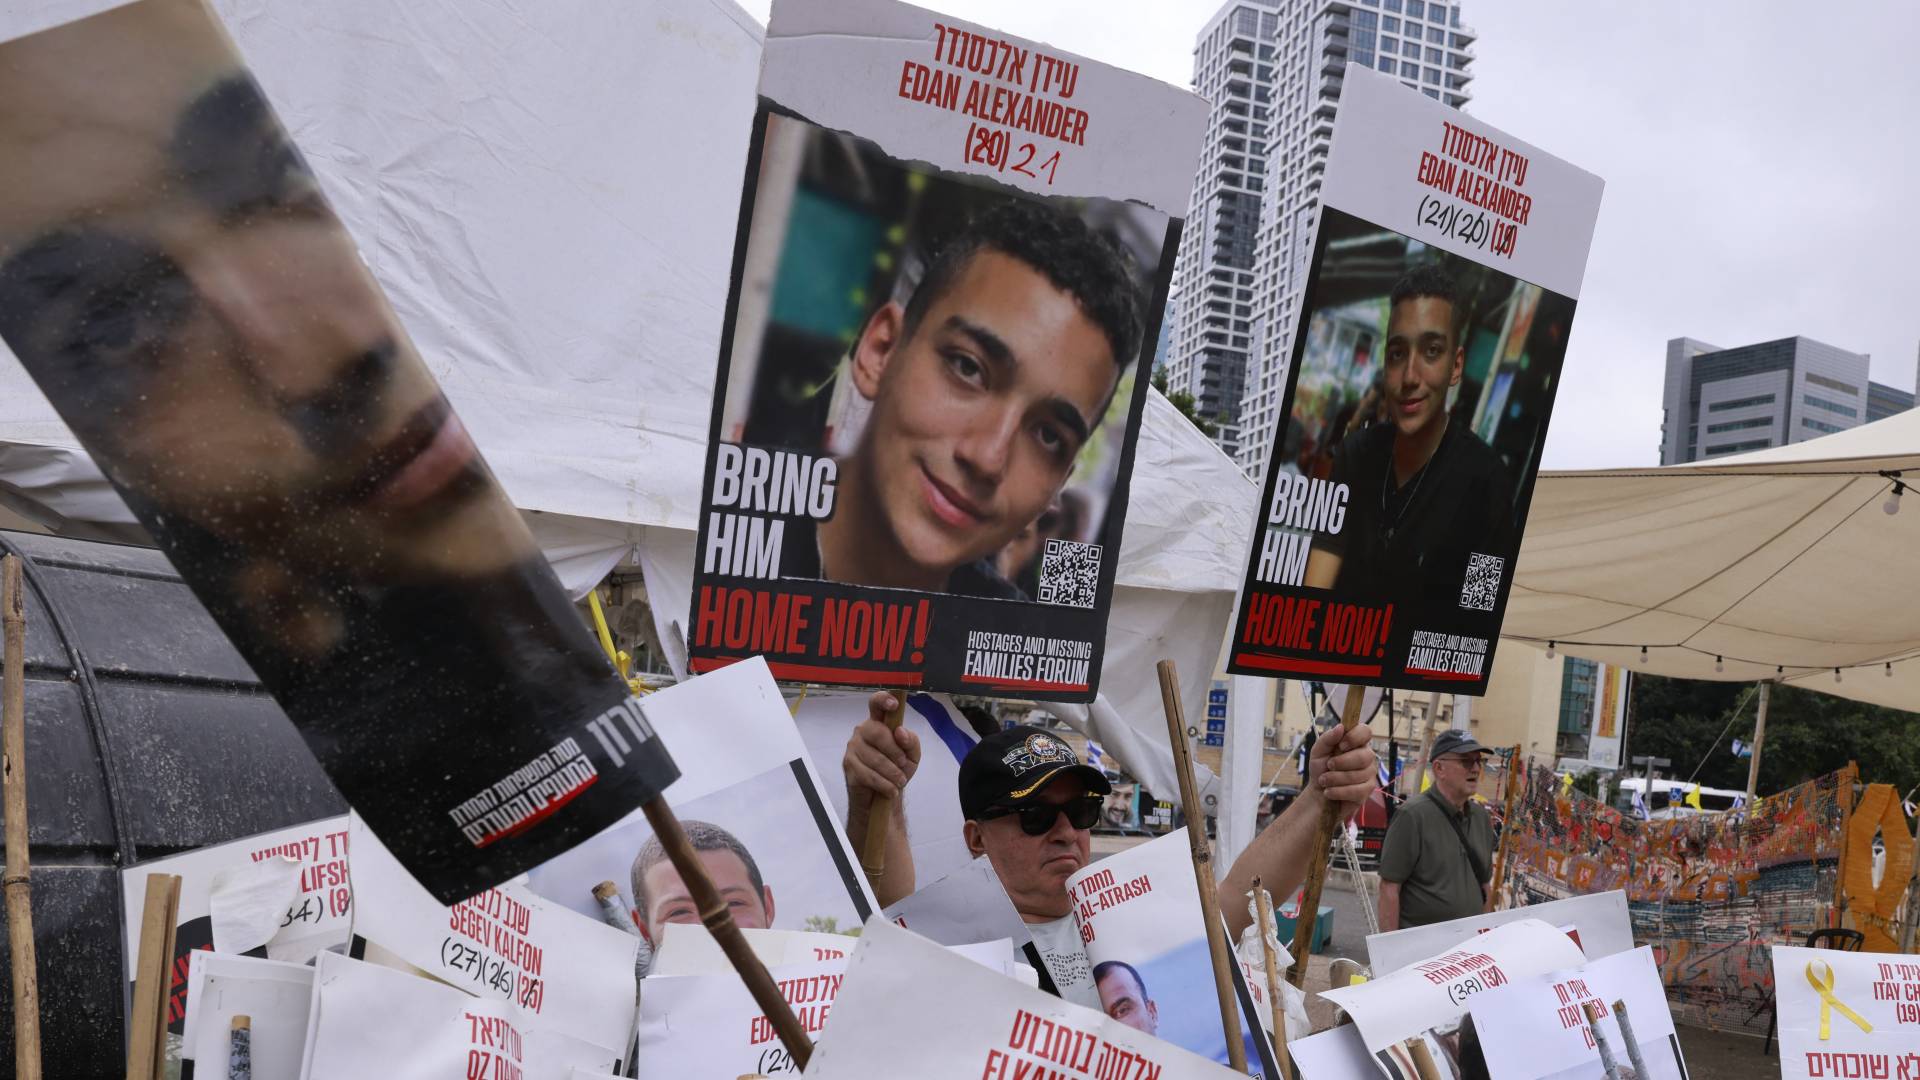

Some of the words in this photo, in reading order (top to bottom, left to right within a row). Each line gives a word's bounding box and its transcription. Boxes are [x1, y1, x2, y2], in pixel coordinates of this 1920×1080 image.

[934, 23, 1028, 85] אלכסנדר
[1030, 53, 1079, 98] עידן
[899, 61, 962, 111] EDAN
[962, 80, 1089, 146] ALEXANDER
[964, 122, 1011, 172] (20)
[1011, 143, 1061, 184] 21
[1441, 121, 1499, 175] אלכסנדר
[1497, 148, 1529, 187] עידן
[1417, 151, 1457, 194] EDAN
[1455, 168, 1532, 226] ALEXANDER
[711, 443, 838, 518] BRING
[1268, 471, 1350, 535] BRING
[703, 512, 785, 580] HIM
[1256, 529, 1313, 587] HIM
[695, 585, 813, 654] HOME
[818, 597, 930, 665] NOW!
[967, 630, 1022, 653] HOSTAGES
[1023, 636, 1045, 656] AND
[1046, 638, 1092, 660] MISSING
[1243, 592, 1321, 650] HOME
[1318, 600, 1393, 659] NOW!
[1412, 630, 1447, 649] HOSTAGES
[1446, 634, 1460, 650] AND
[1460, 636, 1488, 654] MISSING
[964, 650, 1034, 681] FAMILIES
[1035, 656, 1090, 686] FORUM
[1407, 646, 1452, 673] FAMILIES
[1450, 651, 1485, 676] FORUM
[549, 736, 582, 766] מטה
[492, 752, 556, 801] המשפחות
[527, 754, 598, 811] החטופים
[462, 793, 537, 846] והנעדרים
[1078, 869, 1115, 897] מחמד
[1080, 874, 1152, 922] AL-ATRASH
[450, 903, 491, 947] SEGEV
[494, 925, 543, 976] KALFON
[503, 896, 530, 936] שגב
[1424, 964, 1465, 985] EITAN
[1460, 953, 1496, 972] HORN
[1448, 976, 1483, 1006] (38)
[1873, 982, 1900, 1000] ITAY
[1557, 1004, 1583, 1029] ITAY
[467, 1049, 491, 1080] OZ
[1008, 1009, 1098, 1075] בוחבוט
[1806, 1052, 1889, 1080] שוכחים
